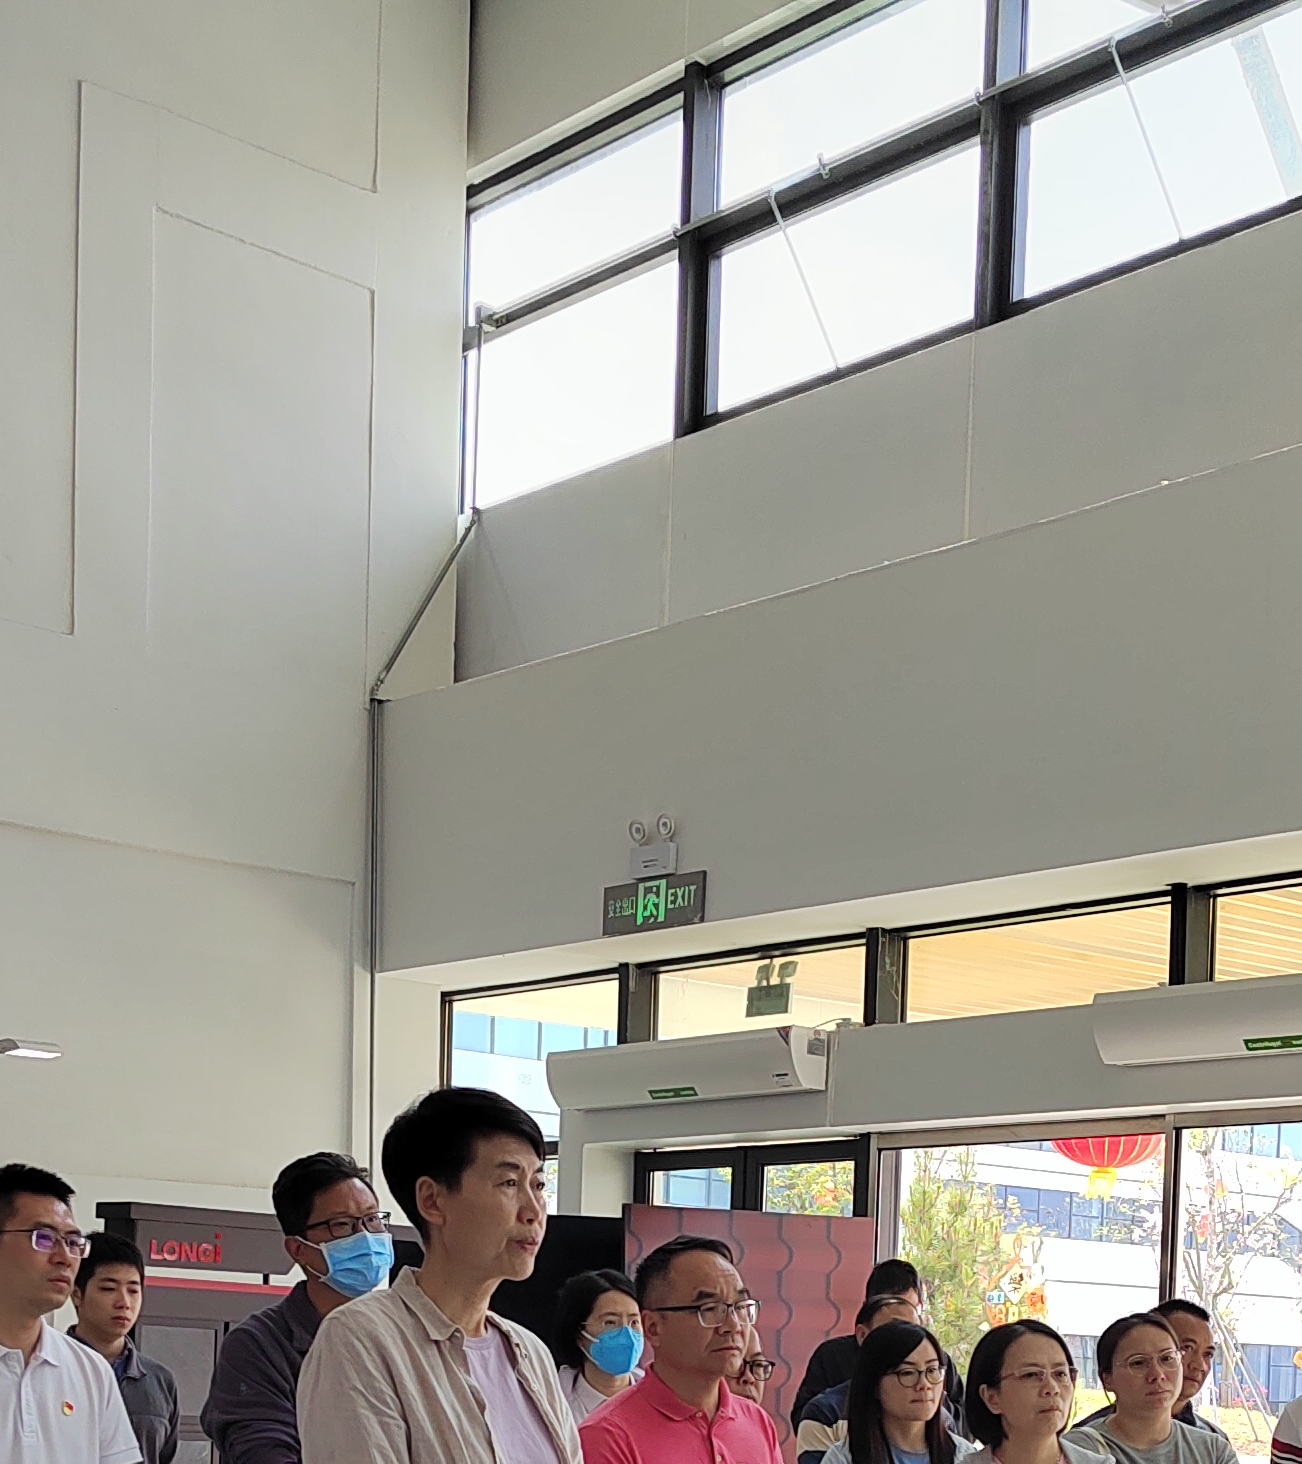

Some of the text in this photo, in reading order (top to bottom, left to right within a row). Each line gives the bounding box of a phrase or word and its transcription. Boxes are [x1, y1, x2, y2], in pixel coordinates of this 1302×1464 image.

[607, 896, 636, 918] 安全出口
[667, 884, 698, 909] EXIT
